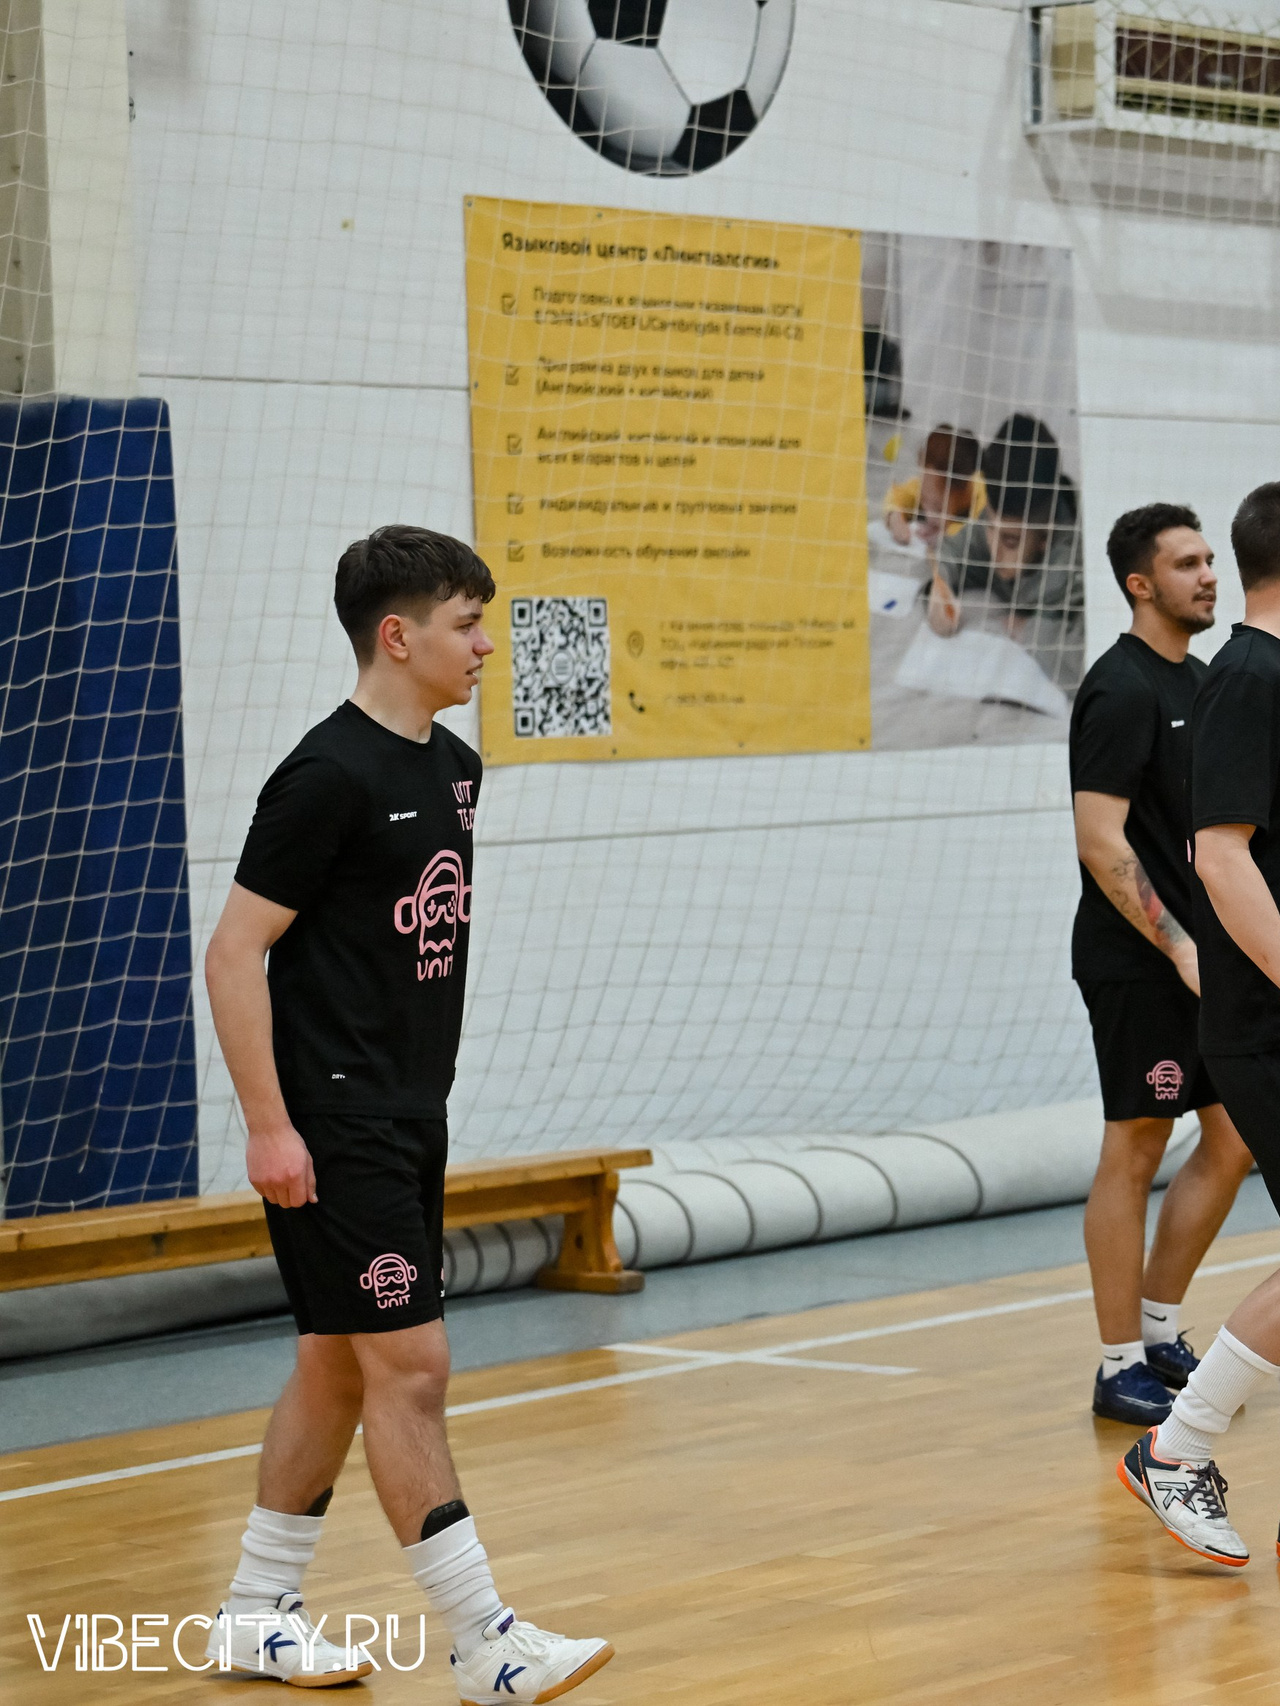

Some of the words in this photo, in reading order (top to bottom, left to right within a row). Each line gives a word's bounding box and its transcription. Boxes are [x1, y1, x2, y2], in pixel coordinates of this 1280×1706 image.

[502, 231, 591, 257] Языковой
[596, 242, 648, 262] центр
[377, 1294, 411, 1309] UNIT
